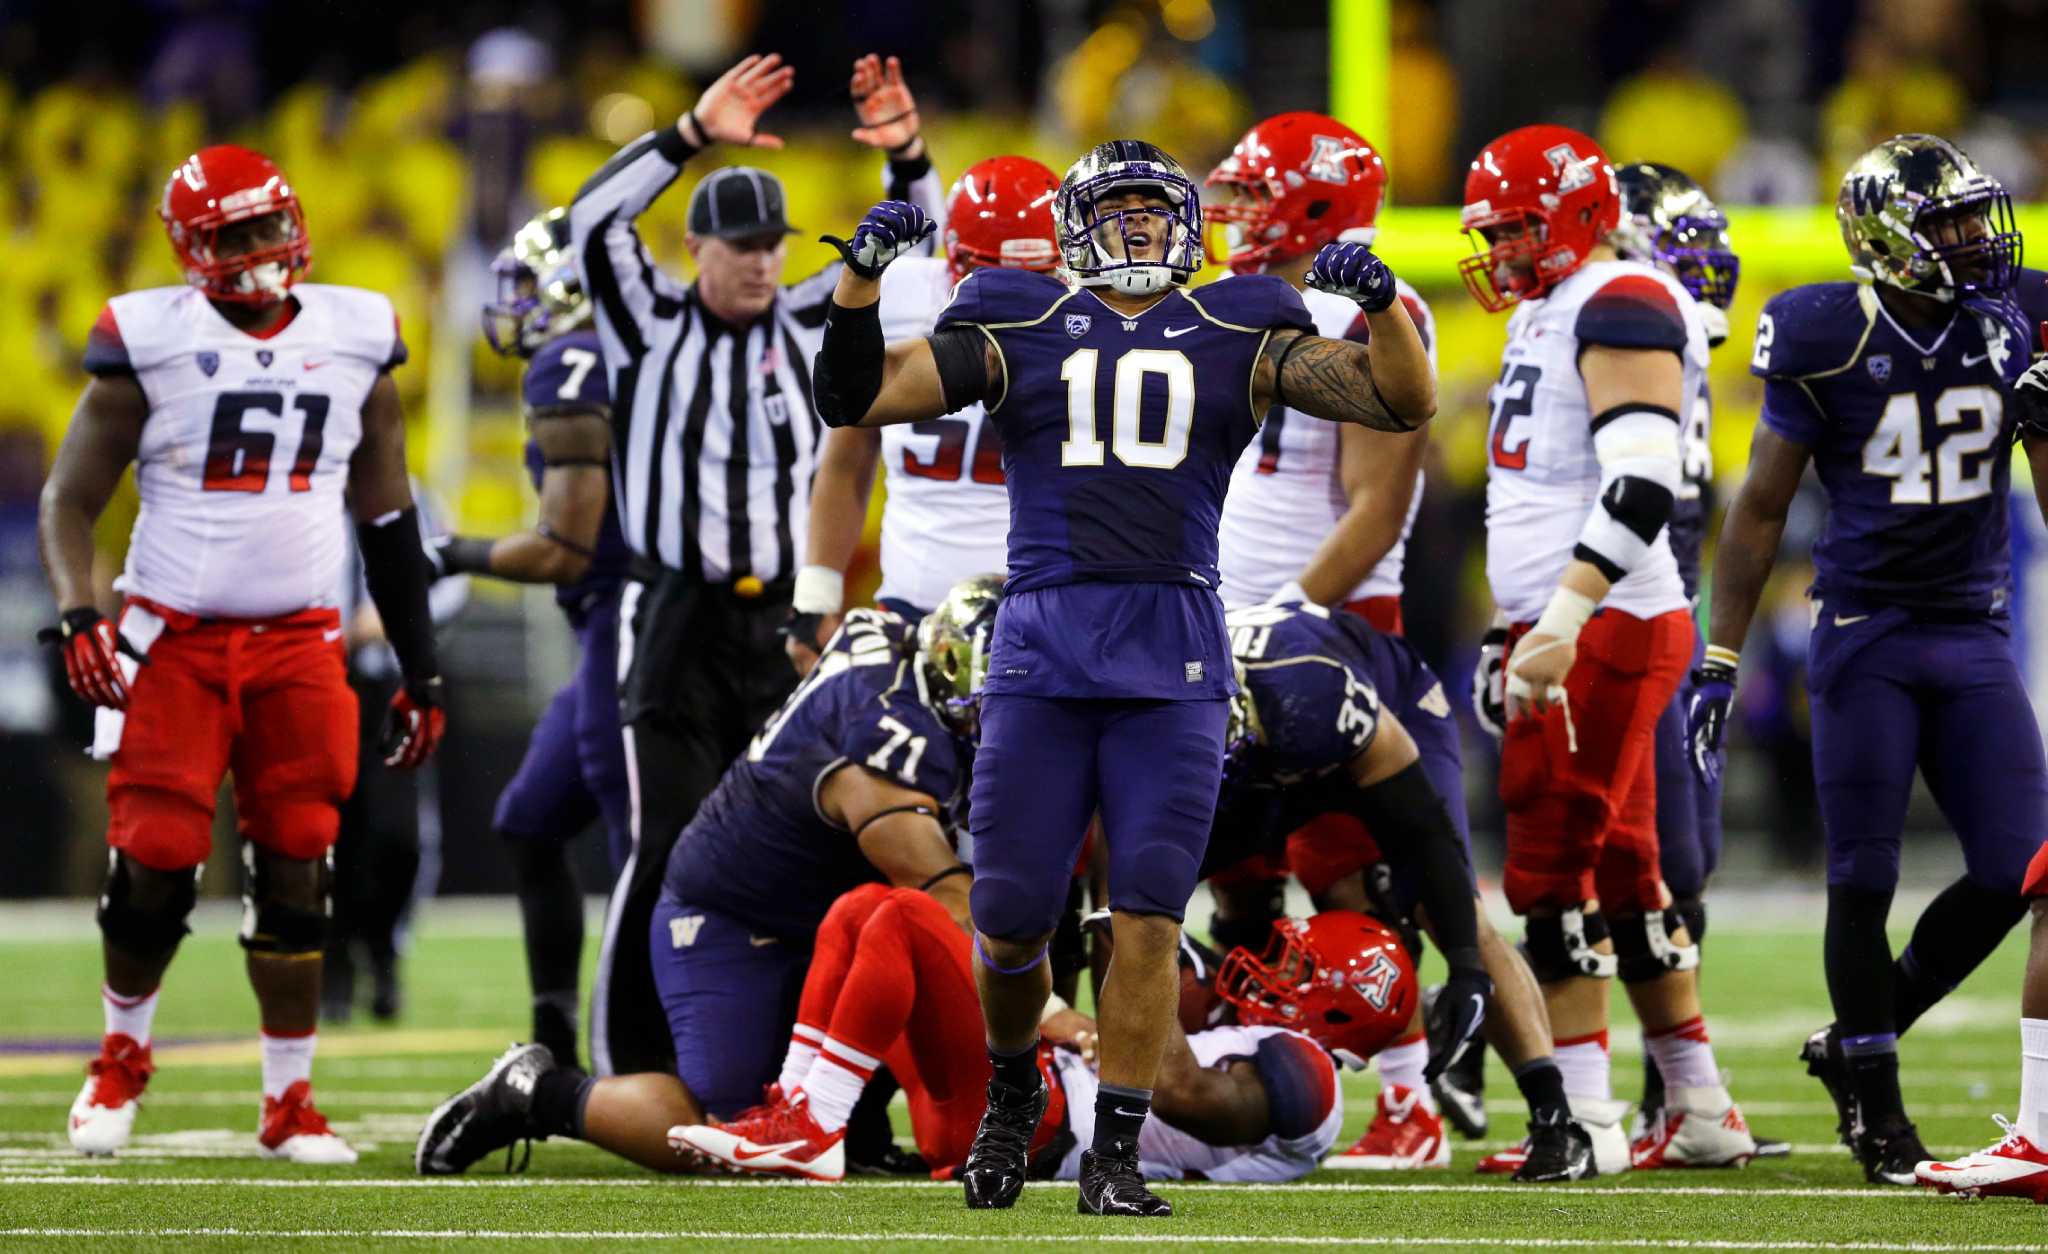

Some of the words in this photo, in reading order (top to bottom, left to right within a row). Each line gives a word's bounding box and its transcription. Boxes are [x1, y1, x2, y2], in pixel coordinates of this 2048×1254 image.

[1852, 173, 1895, 217] W
[1121, 321, 1139, 332] W
[557, 347, 597, 400] 7
[1060, 348, 1196, 471] 10
[202, 391, 331, 494] 61
[1862, 385, 2004, 504] 42
[866, 715, 928, 784] 71
[668, 914, 706, 950] W
